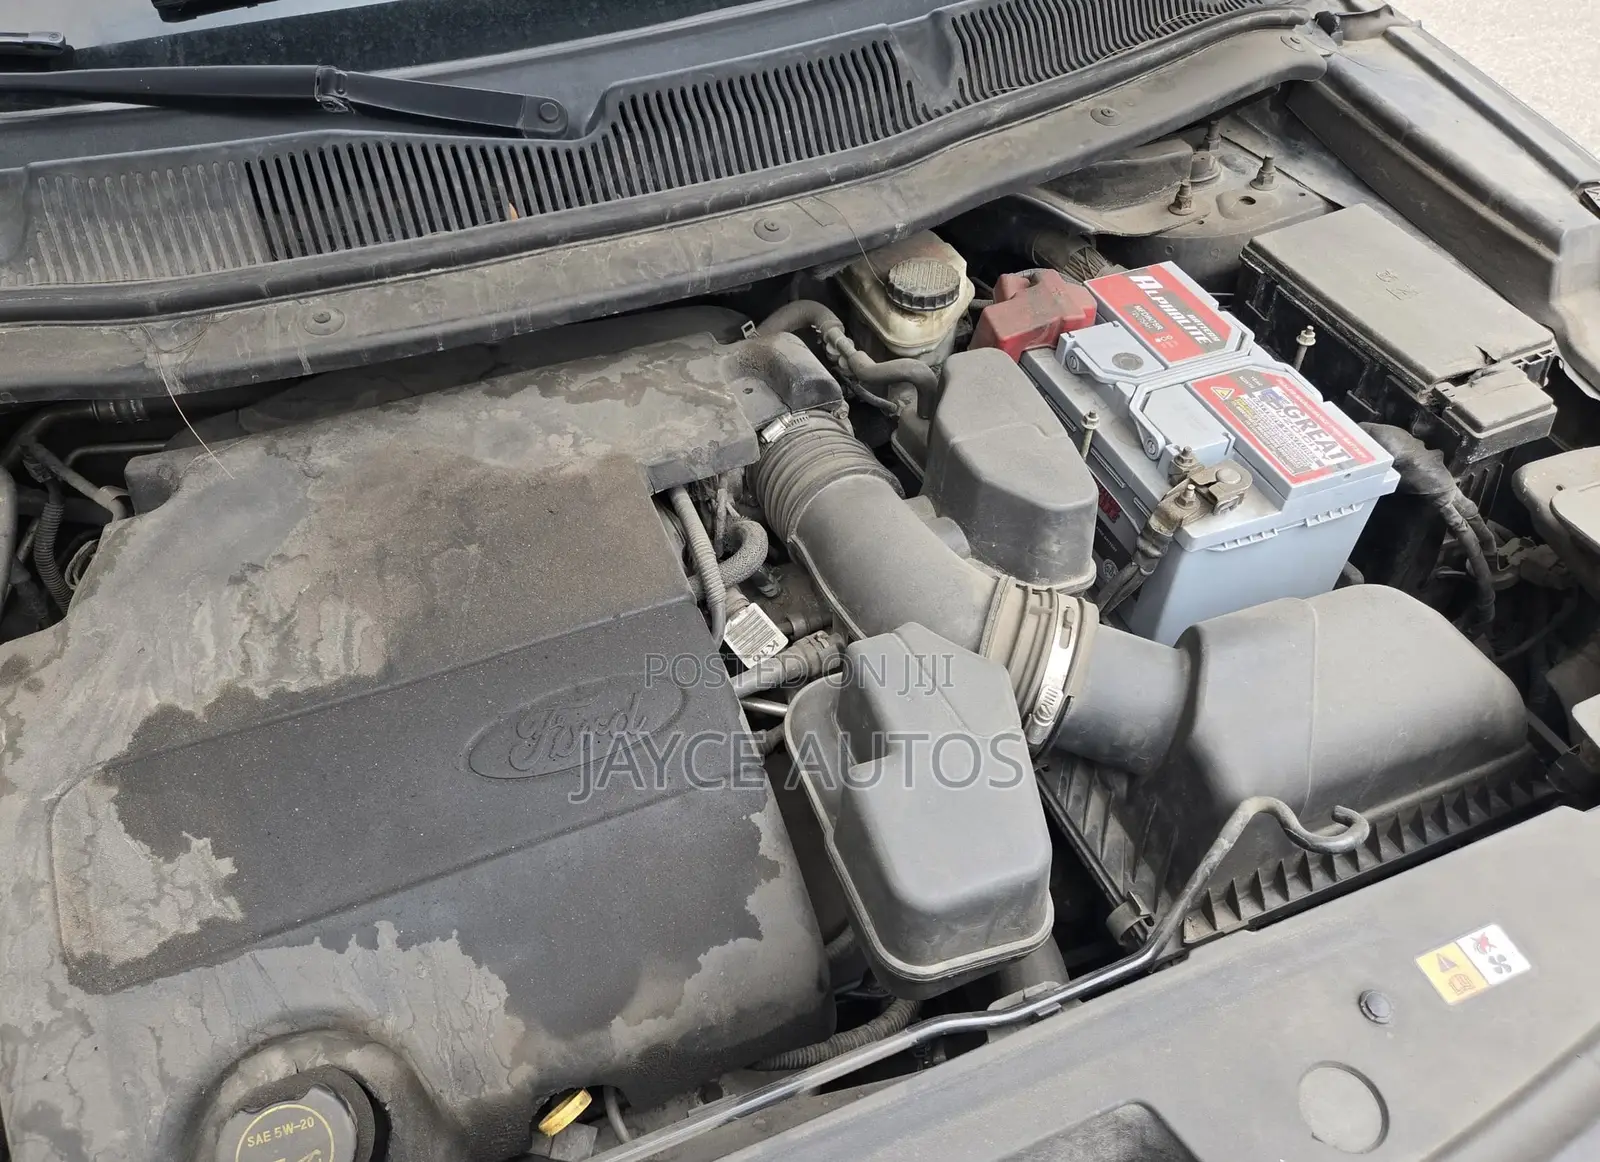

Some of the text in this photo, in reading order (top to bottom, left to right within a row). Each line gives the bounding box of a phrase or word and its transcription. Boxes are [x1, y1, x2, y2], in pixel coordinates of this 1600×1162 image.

[1129, 275, 1213, 344] ALPHALITE
[1283, 404, 1352, 461] GREAT
[246, 1116, 315, 1148] SAE 5W-20
